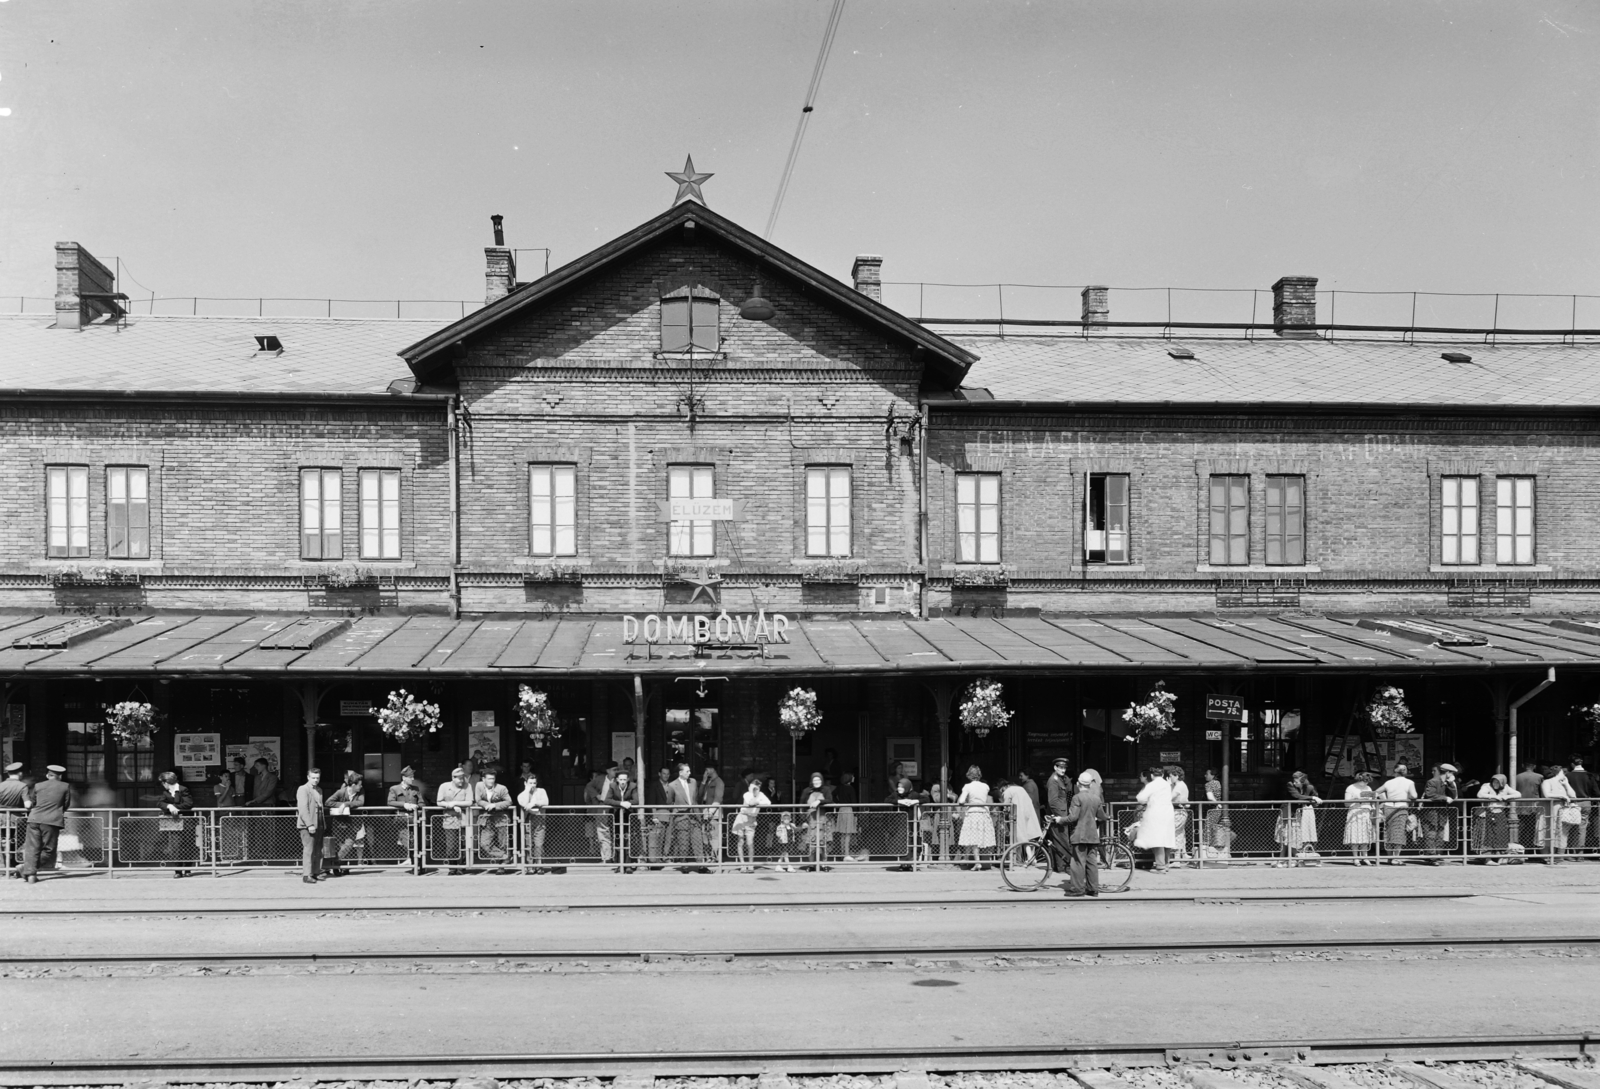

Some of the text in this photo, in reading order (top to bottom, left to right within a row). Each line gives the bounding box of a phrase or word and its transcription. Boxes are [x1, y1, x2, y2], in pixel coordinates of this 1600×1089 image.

[672, 502, 732, 516] ÉLÜZEM
[623, 609, 789, 643] DOMBÓVÁR
[1208, 698, 1241, 708] POSTA
